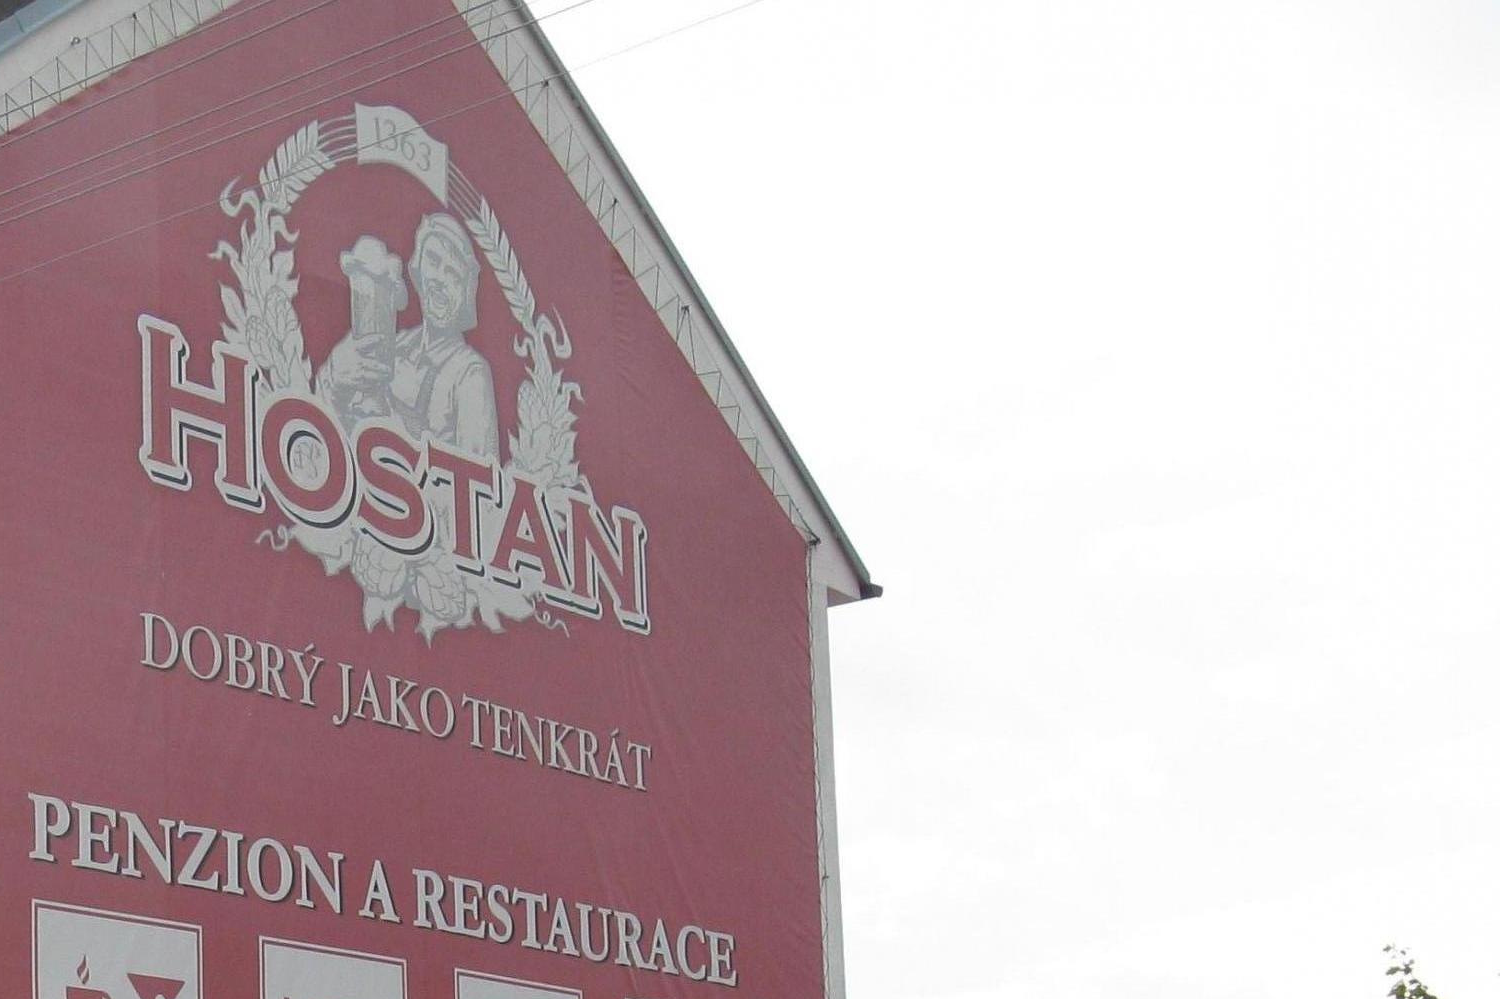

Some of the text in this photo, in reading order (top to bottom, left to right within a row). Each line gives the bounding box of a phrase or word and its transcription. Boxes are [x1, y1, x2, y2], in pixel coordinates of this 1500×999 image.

[373, 116, 432, 173] 1363
[138, 312, 652, 635] HOSTAN
[138, 611, 652, 792] DOBRÝ JAKO TENKRÁT
[28, 791, 738, 987] PENZION A RESTAURACE
